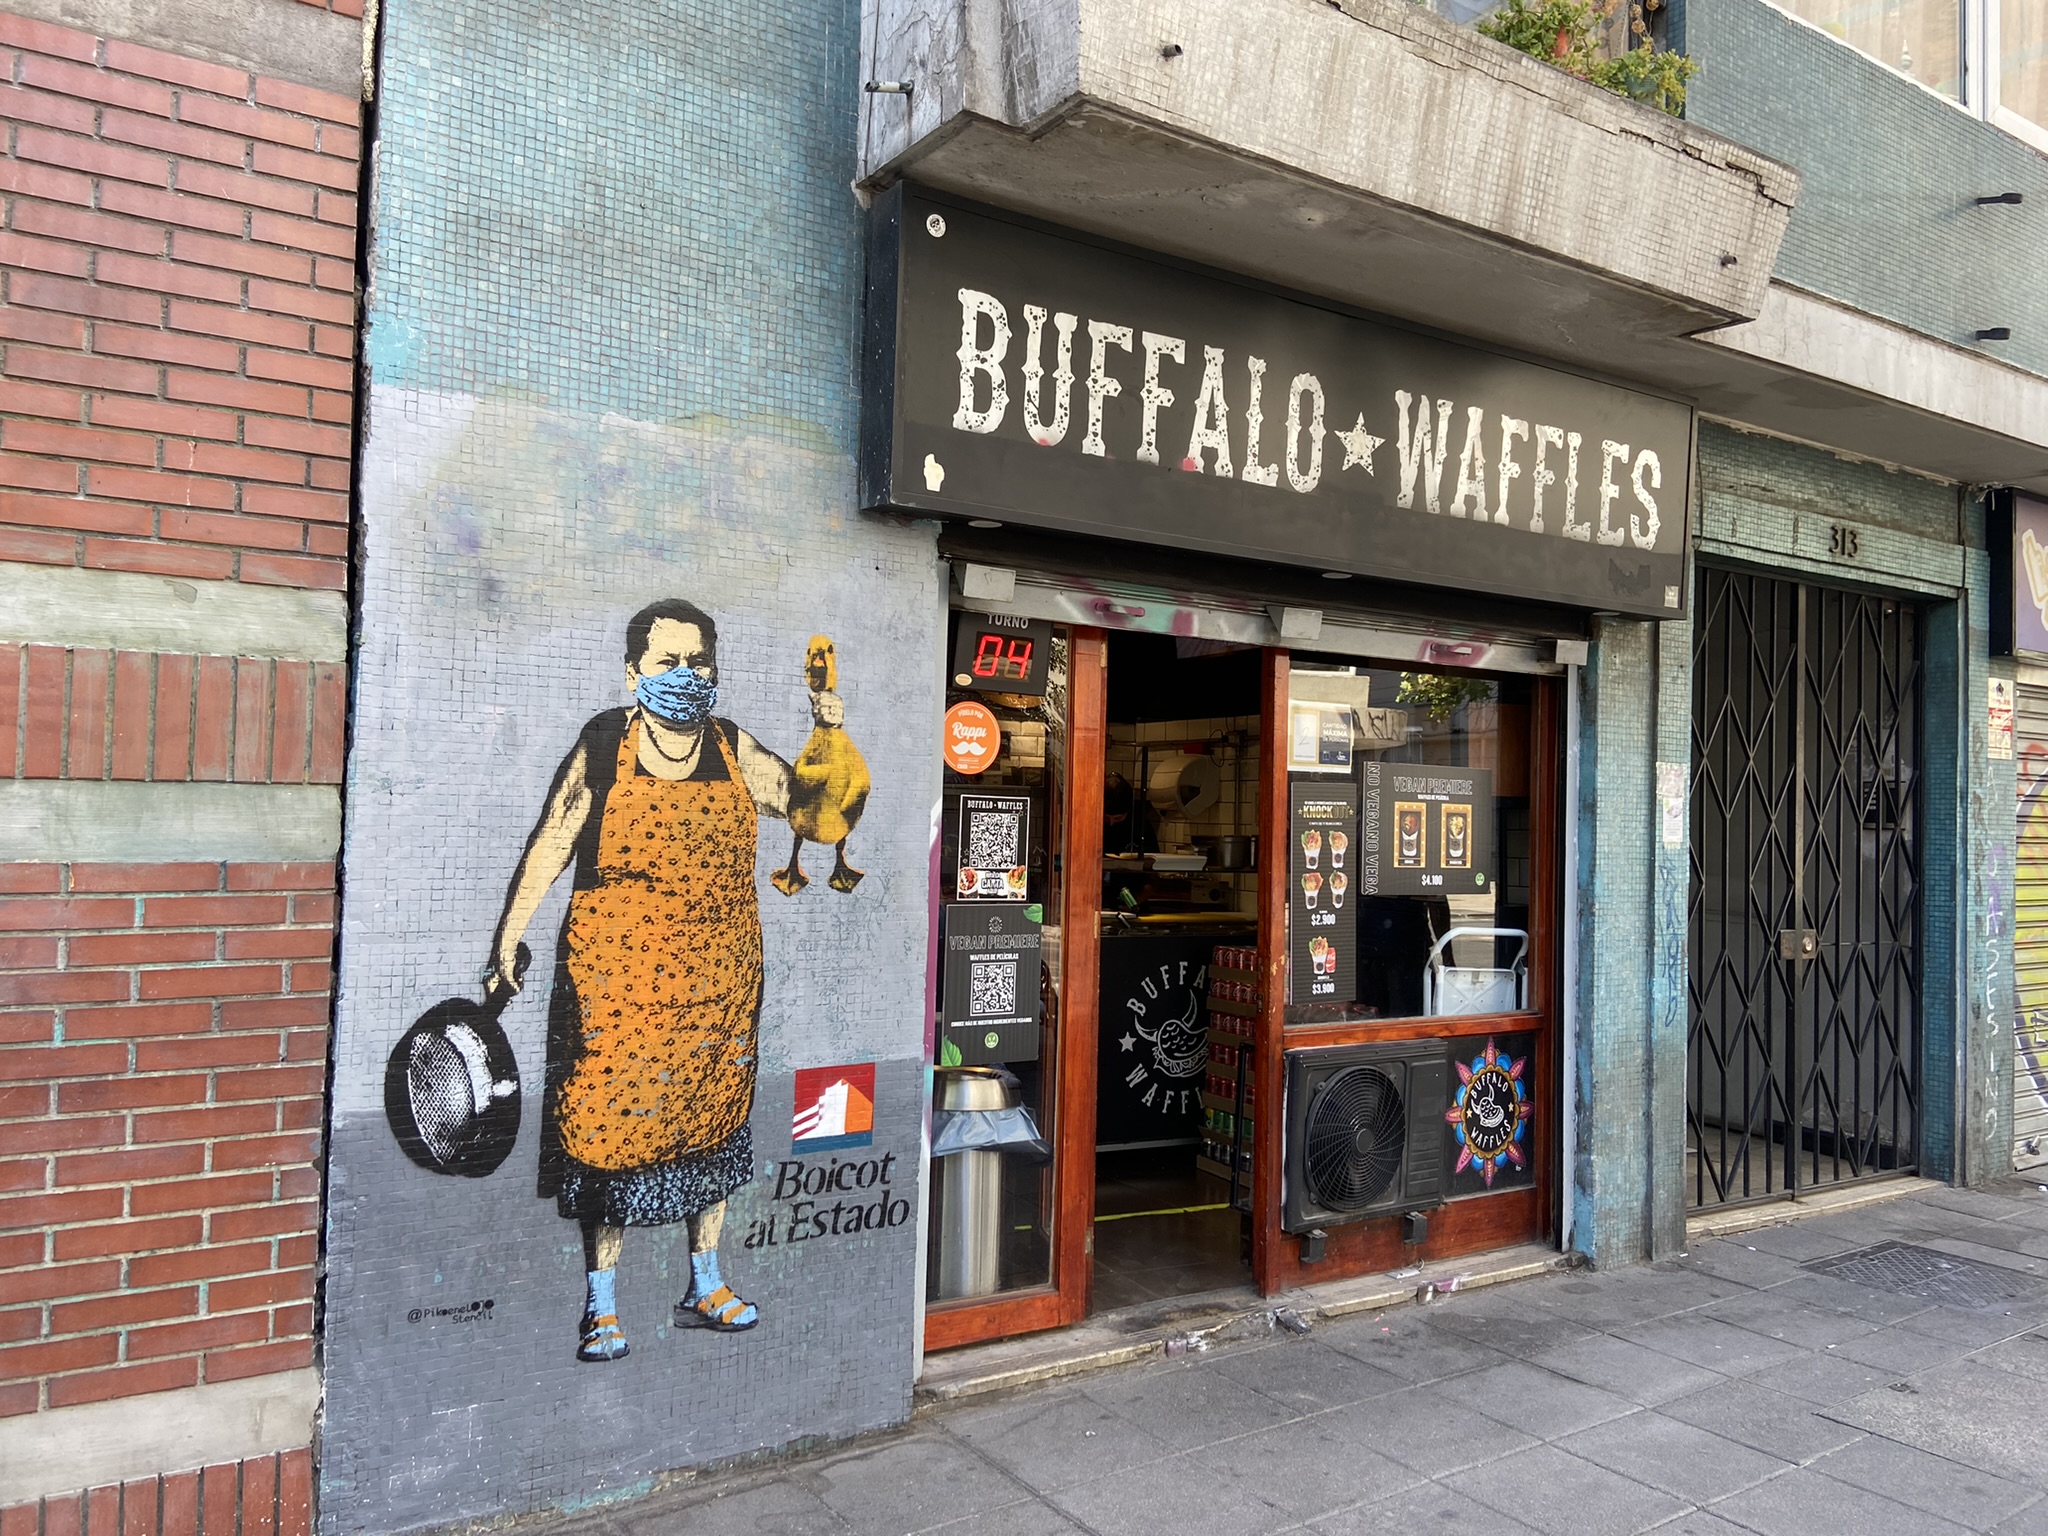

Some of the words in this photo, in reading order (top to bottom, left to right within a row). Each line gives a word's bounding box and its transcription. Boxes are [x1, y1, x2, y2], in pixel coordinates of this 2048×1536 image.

[953, 287, 1326, 493] BUFFALO
[1395, 389, 1661, 550] WAFFLES
[1829, 525, 1858, 558] 313
[987, 613, 1029, 629] TURNO
[974, 635, 1032, 678] 04
[952, 721, 987, 740] Rappi
[1366, 761, 1380, 786] NO
[1393, 776, 1427, 793] VEGAN
[1427, 777, 1473, 795] PREMIERE
[1366, 789, 1380, 852] VEGANO
[948, 935, 986, 950] VEGAN
[987, 933, 1040, 949] PREMIERE
[1126, 961, 1206, 1017] BUFFA
[1470, 1072, 1509, 1099] BUFFALO
[1470, 1119, 1511, 1148] WAFFLES
[772, 1151, 896, 1200] Boicot
[744, 1214, 777, 1249] al
[787, 1190, 910, 1243] Estado
